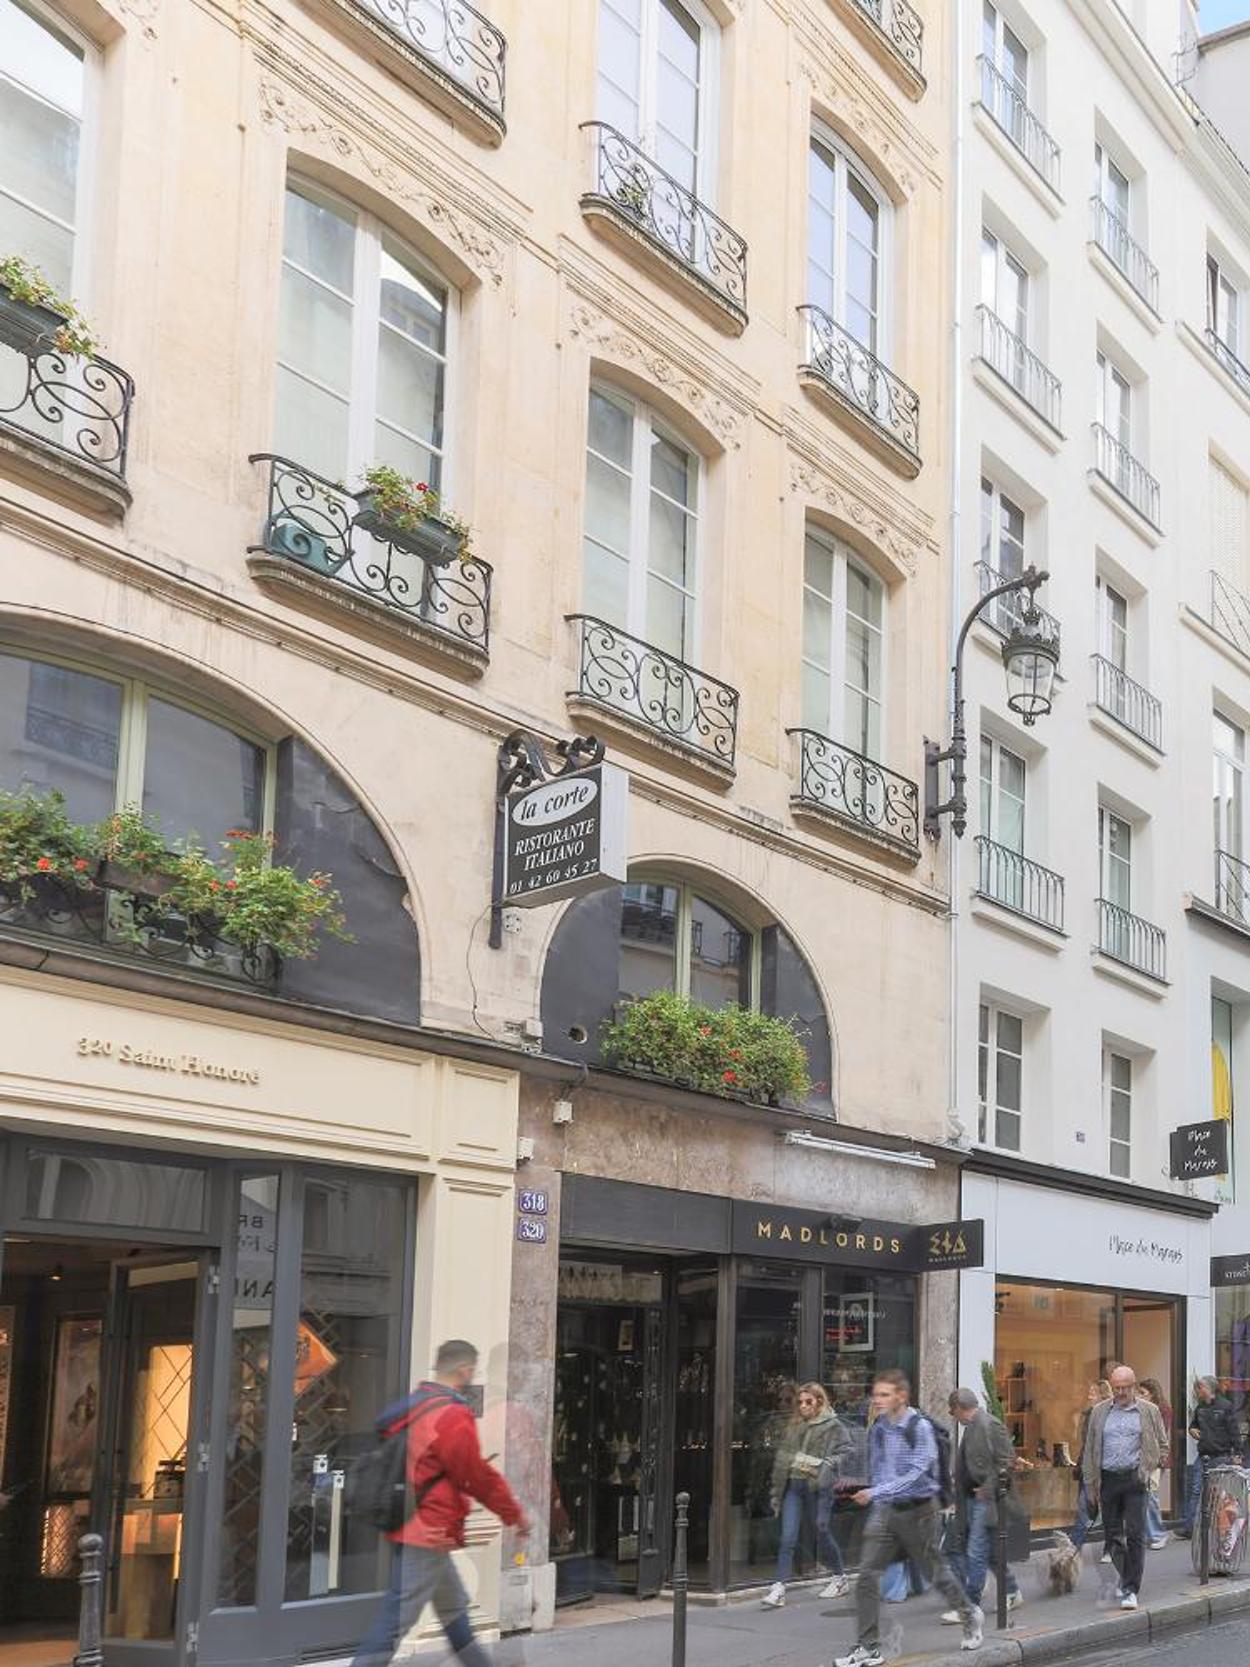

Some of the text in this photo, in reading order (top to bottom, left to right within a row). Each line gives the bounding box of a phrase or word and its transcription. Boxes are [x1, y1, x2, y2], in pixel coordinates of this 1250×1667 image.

[520, 785, 589, 821] la corte
[515, 818, 595, 856] RISTORANTE
[524, 840, 584, 871] ITALIANO
[509, 858, 598, 894] 01 42 60 45 27
[78, 1038, 112, 1057] 320
[119, 1045, 176, 1073] Saint
[523, 1193, 544, 1210] 318
[522, 1221, 544, 1239] 320
[757, 1221, 900, 1254] MADLORDS
